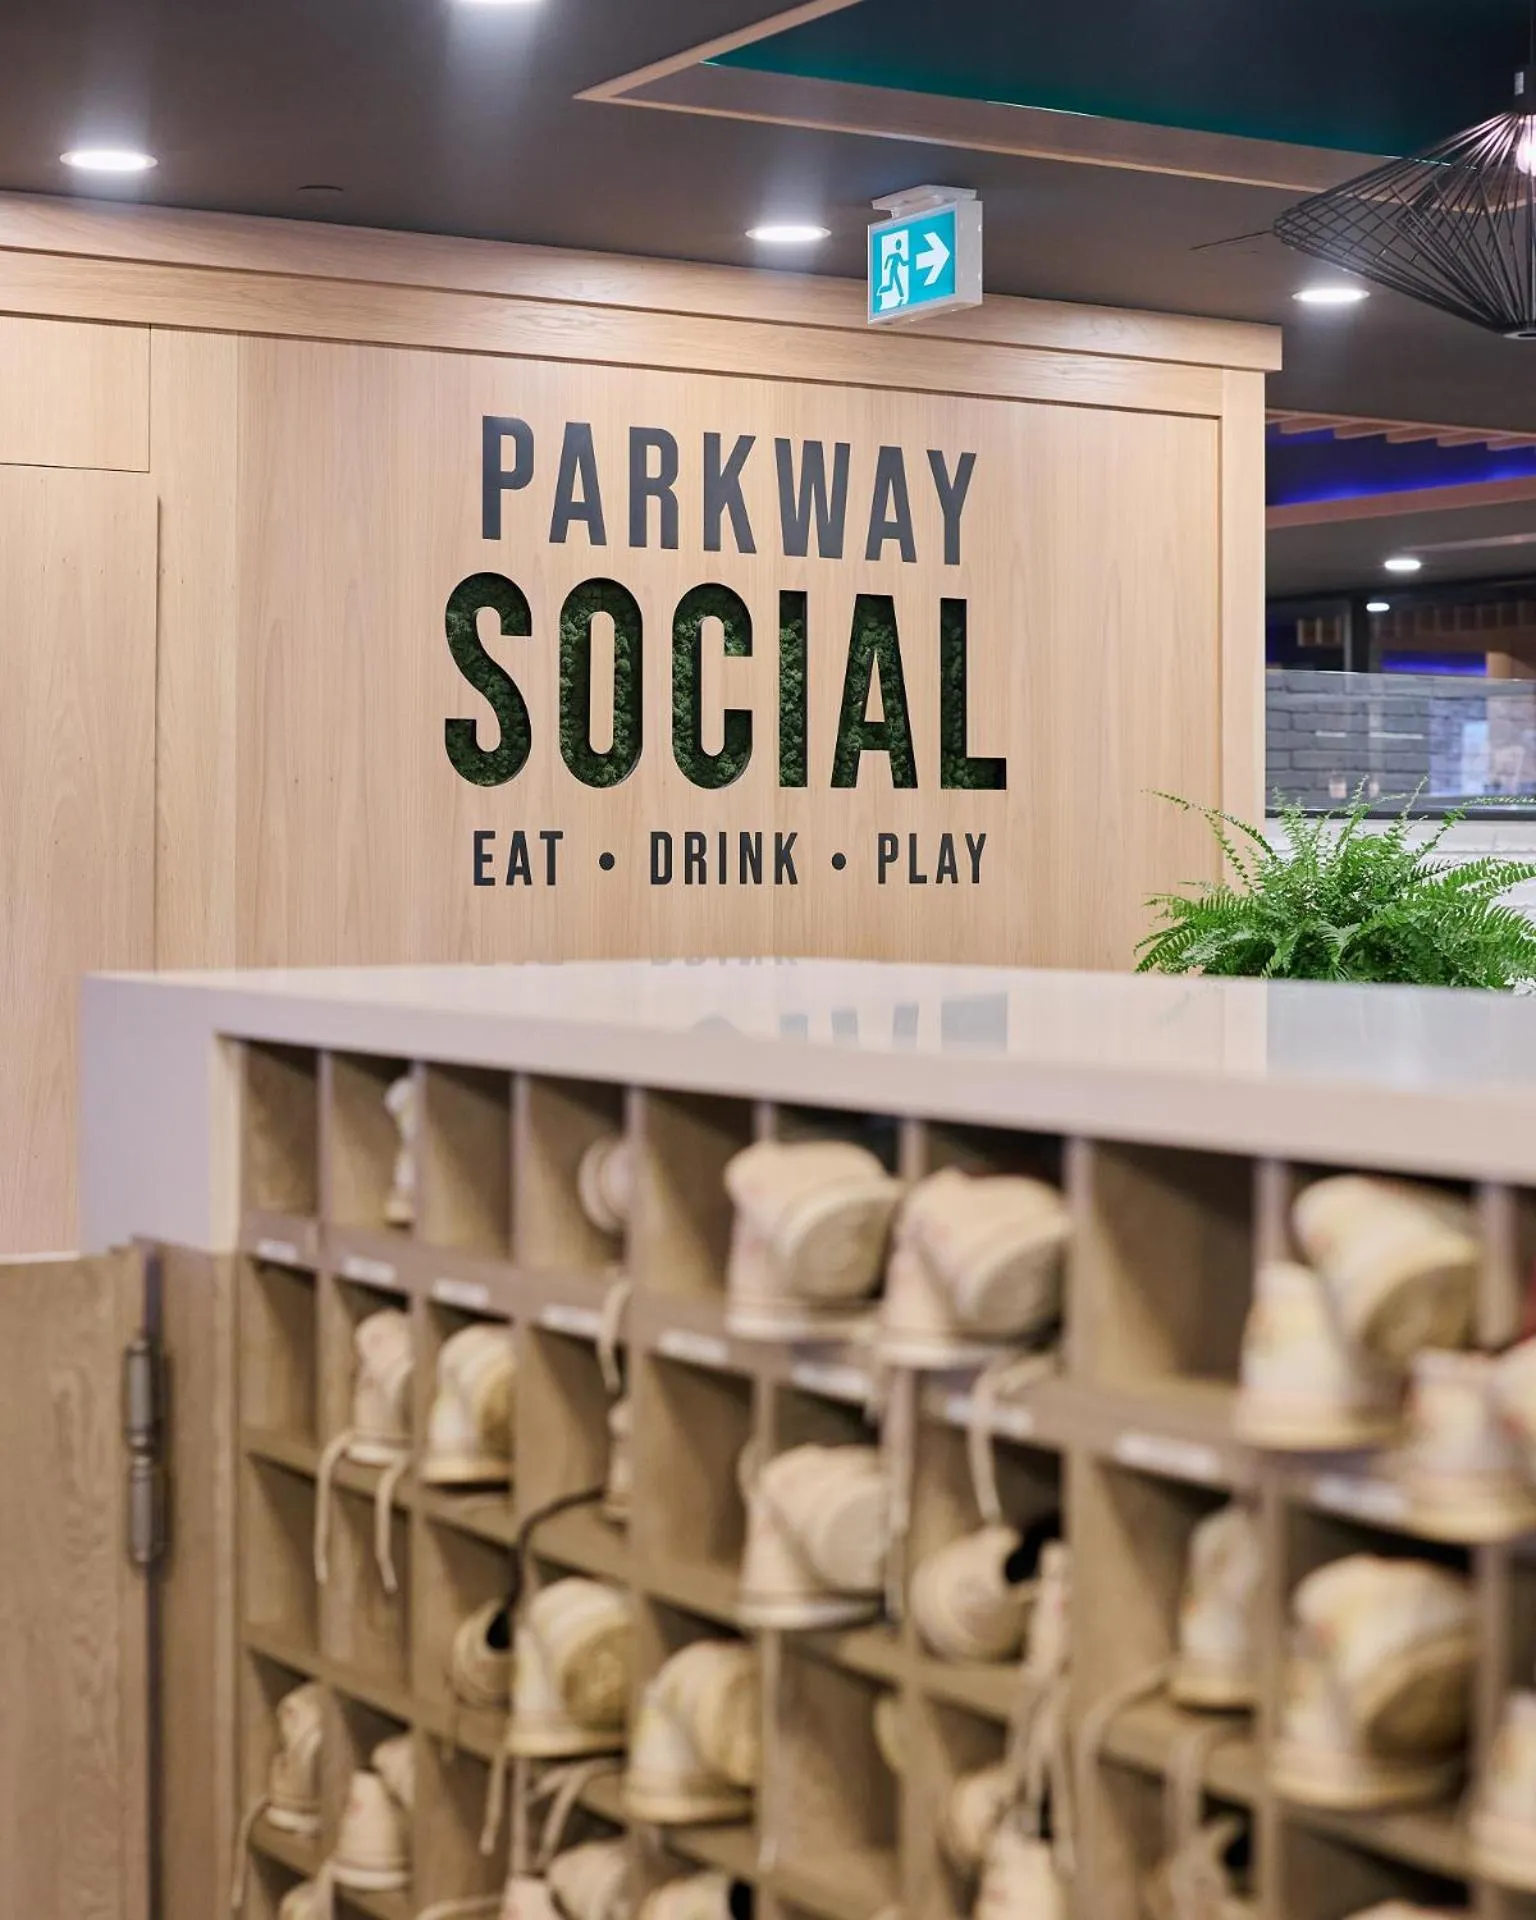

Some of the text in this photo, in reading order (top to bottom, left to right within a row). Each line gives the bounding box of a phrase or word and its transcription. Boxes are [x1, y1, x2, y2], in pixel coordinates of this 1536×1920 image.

[482, 415, 977, 566] PARKWAY
[444, 571, 1007, 791] SOCIAL
[473, 830, 987, 887] EAT DRINK PLAY
